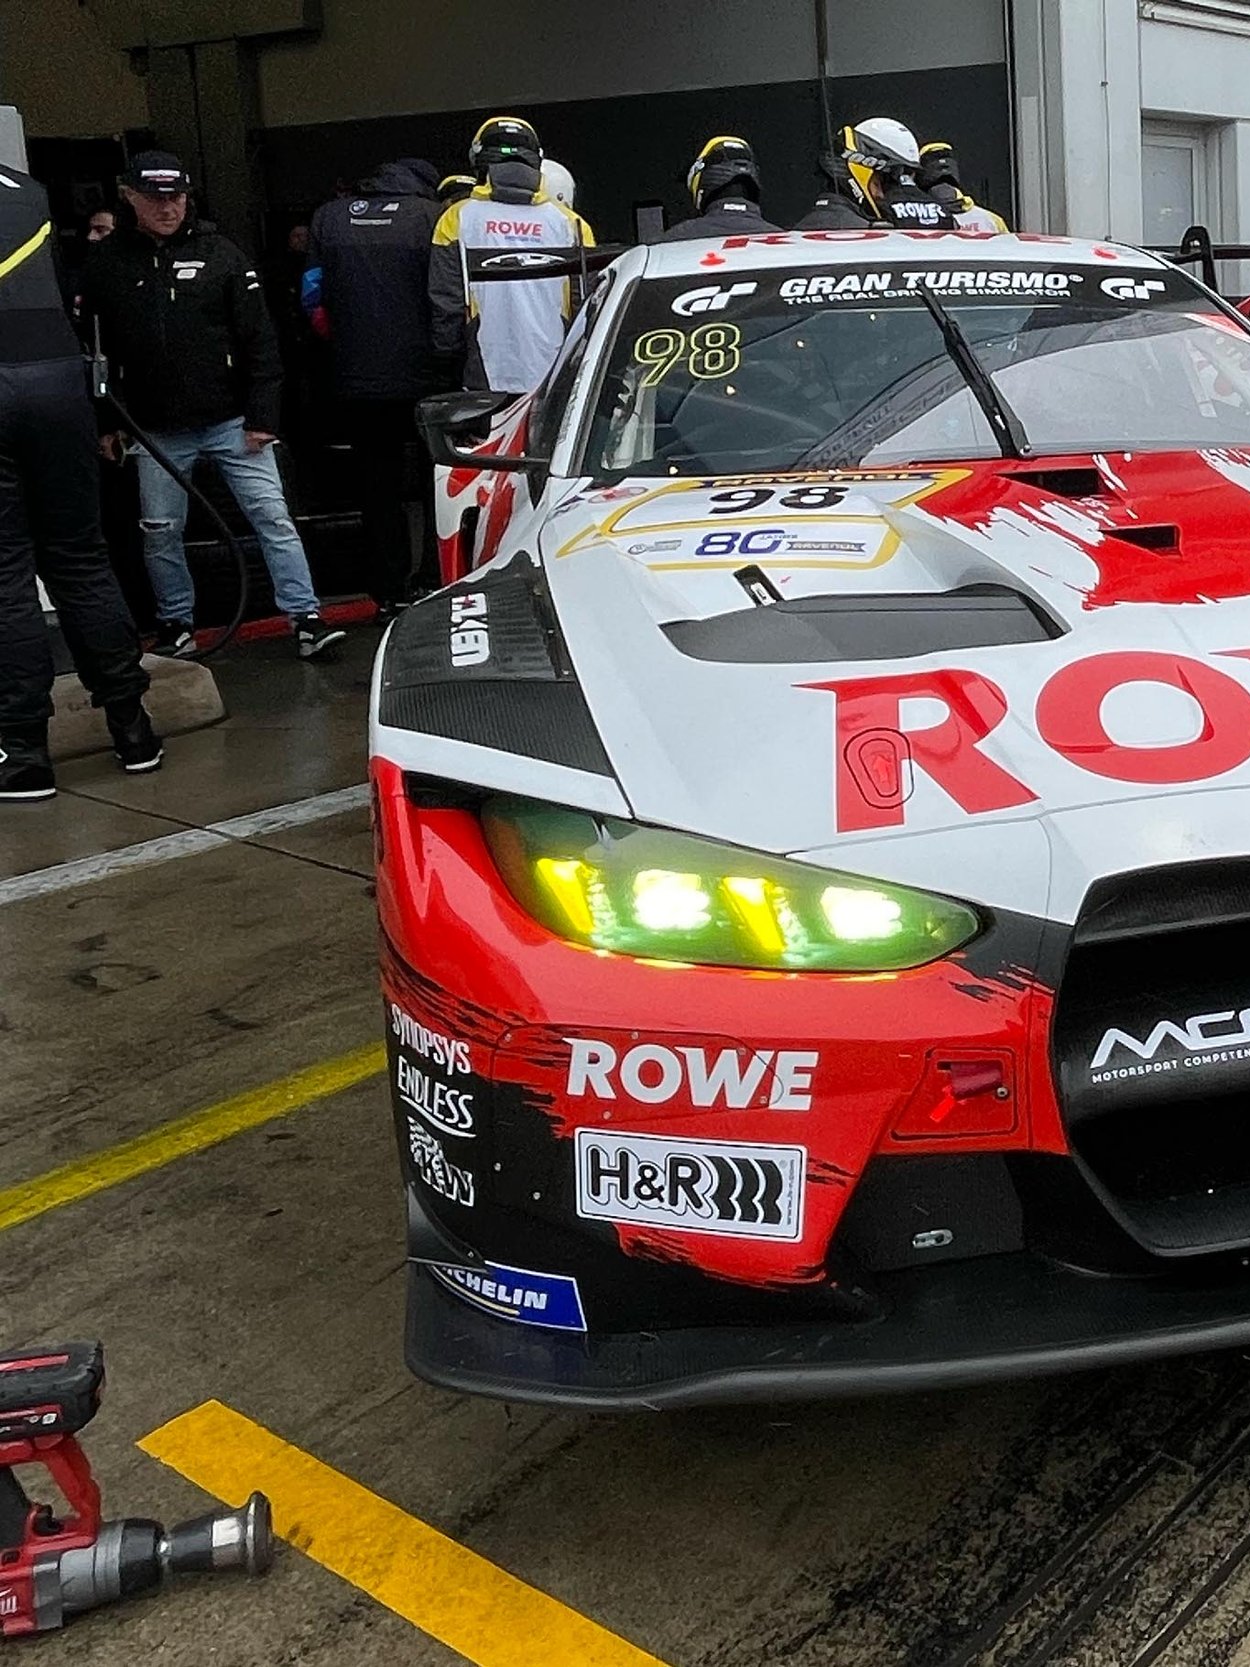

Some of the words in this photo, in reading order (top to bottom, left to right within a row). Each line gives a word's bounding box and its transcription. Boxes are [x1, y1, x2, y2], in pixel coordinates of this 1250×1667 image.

[486, 220, 543, 236] ROWE
[779, 273, 892, 297] GRAN
[902, 271, 1068, 290] TURISMO
[783, 295, 824, 306] THE
[829, 291, 880, 302] REAL
[966, 287, 1071, 298] SIMULATOR
[634, 321, 741, 388] 98
[709, 486, 851, 514] 98
[695, 529, 785, 556] 80
[561, 1037, 819, 1111] ROWE
[1092, 1060, 1178, 1083] MOTORSPORT
[397, 1055, 474, 1129] ENDLESS
[590, 1147, 704, 1209] H&R
